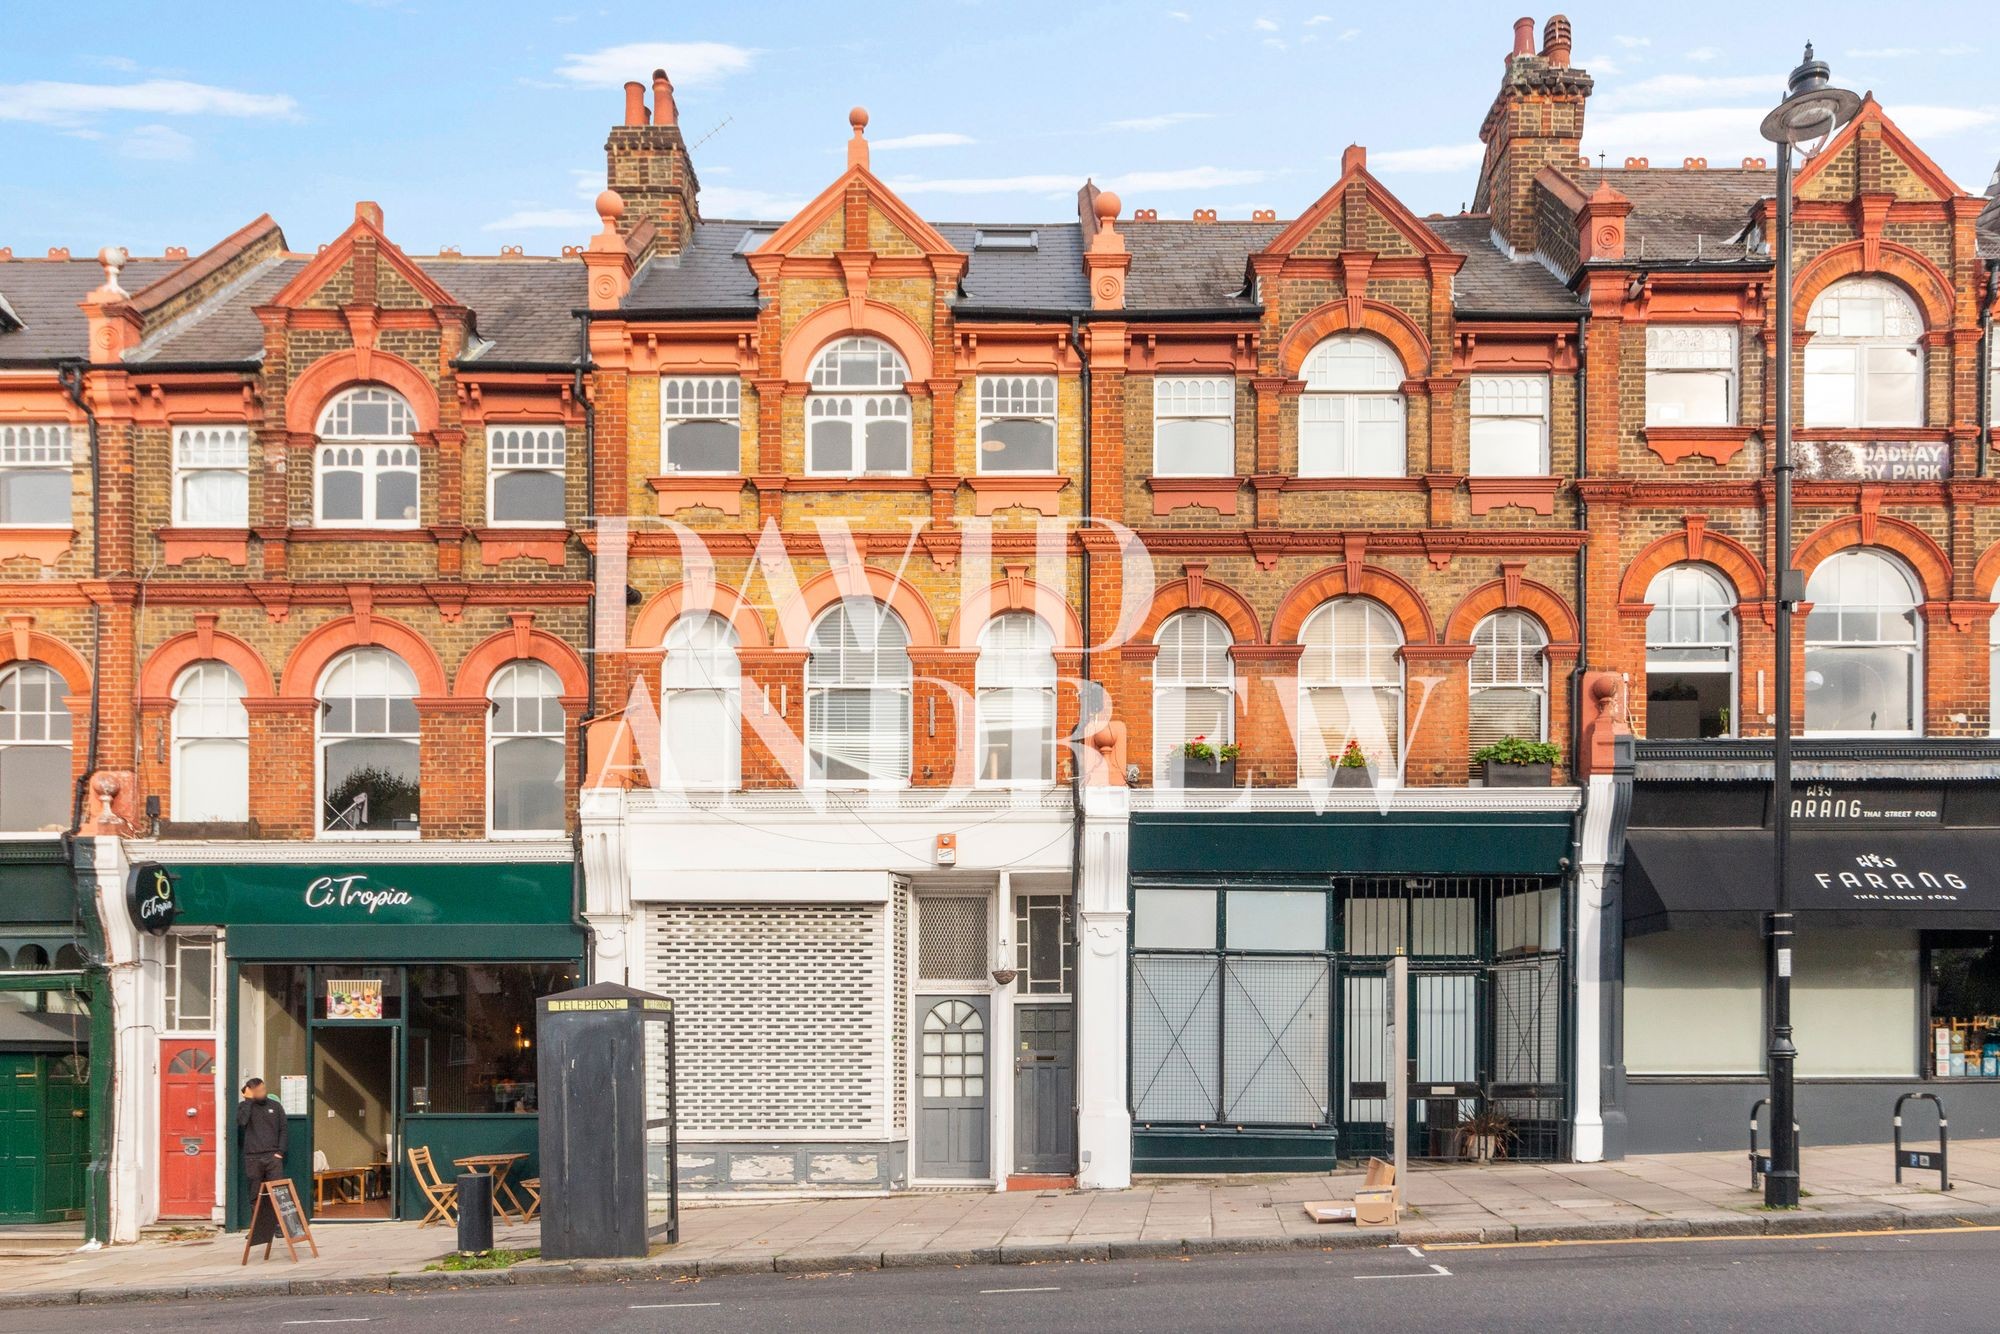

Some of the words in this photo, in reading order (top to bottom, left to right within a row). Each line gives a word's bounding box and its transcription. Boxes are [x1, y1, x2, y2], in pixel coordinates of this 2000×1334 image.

[1892, 464, 1942, 480] PARK
[1790, 800, 1861, 818] ARANG
[1814, 872, 1968, 889] FARANG
[556, 1000, 621, 1010] TELEPHONE
